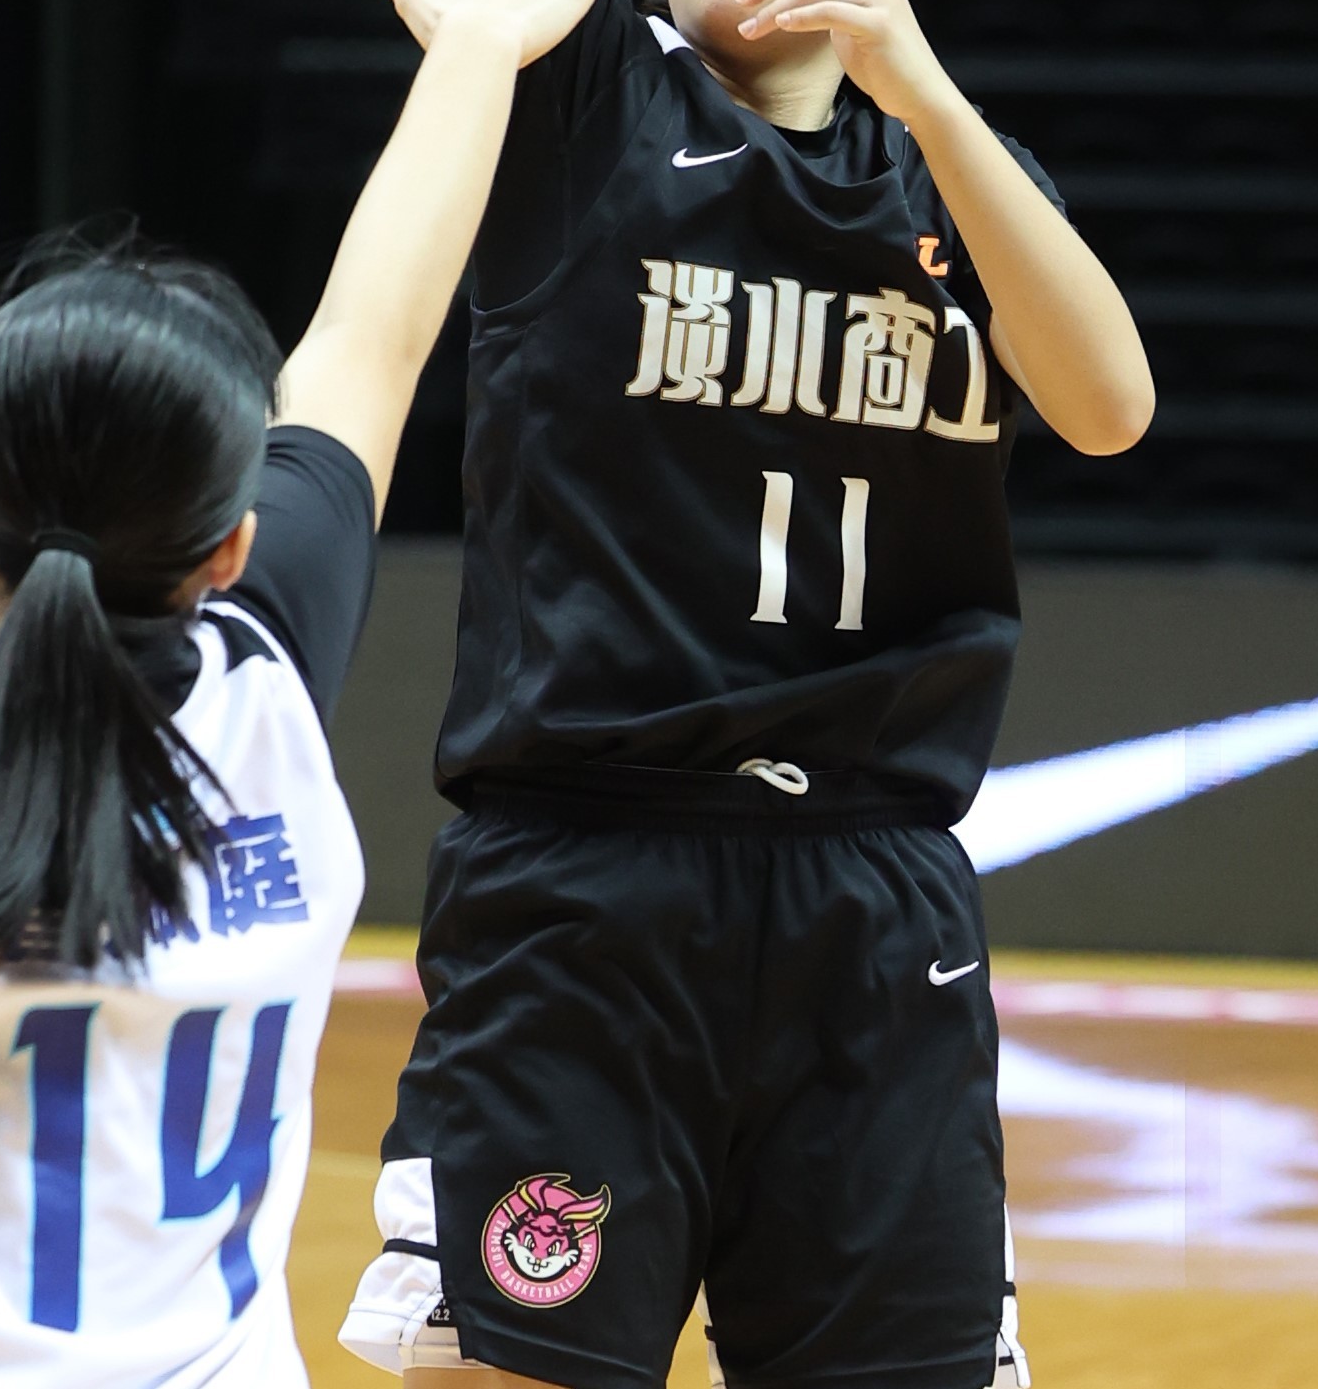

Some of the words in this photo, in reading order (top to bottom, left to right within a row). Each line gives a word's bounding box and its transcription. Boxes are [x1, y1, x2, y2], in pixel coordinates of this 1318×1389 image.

[625, 258, 1000, 444] 淡水商工
[749, 470, 871, 631] 11
[10, 998, 298, 1334] 14
[490, 1219, 508, 1268] TAMSUI
[500, 1269, 575, 1299] BASKETBALL
[573, 1242, 593, 1278] TEAM
